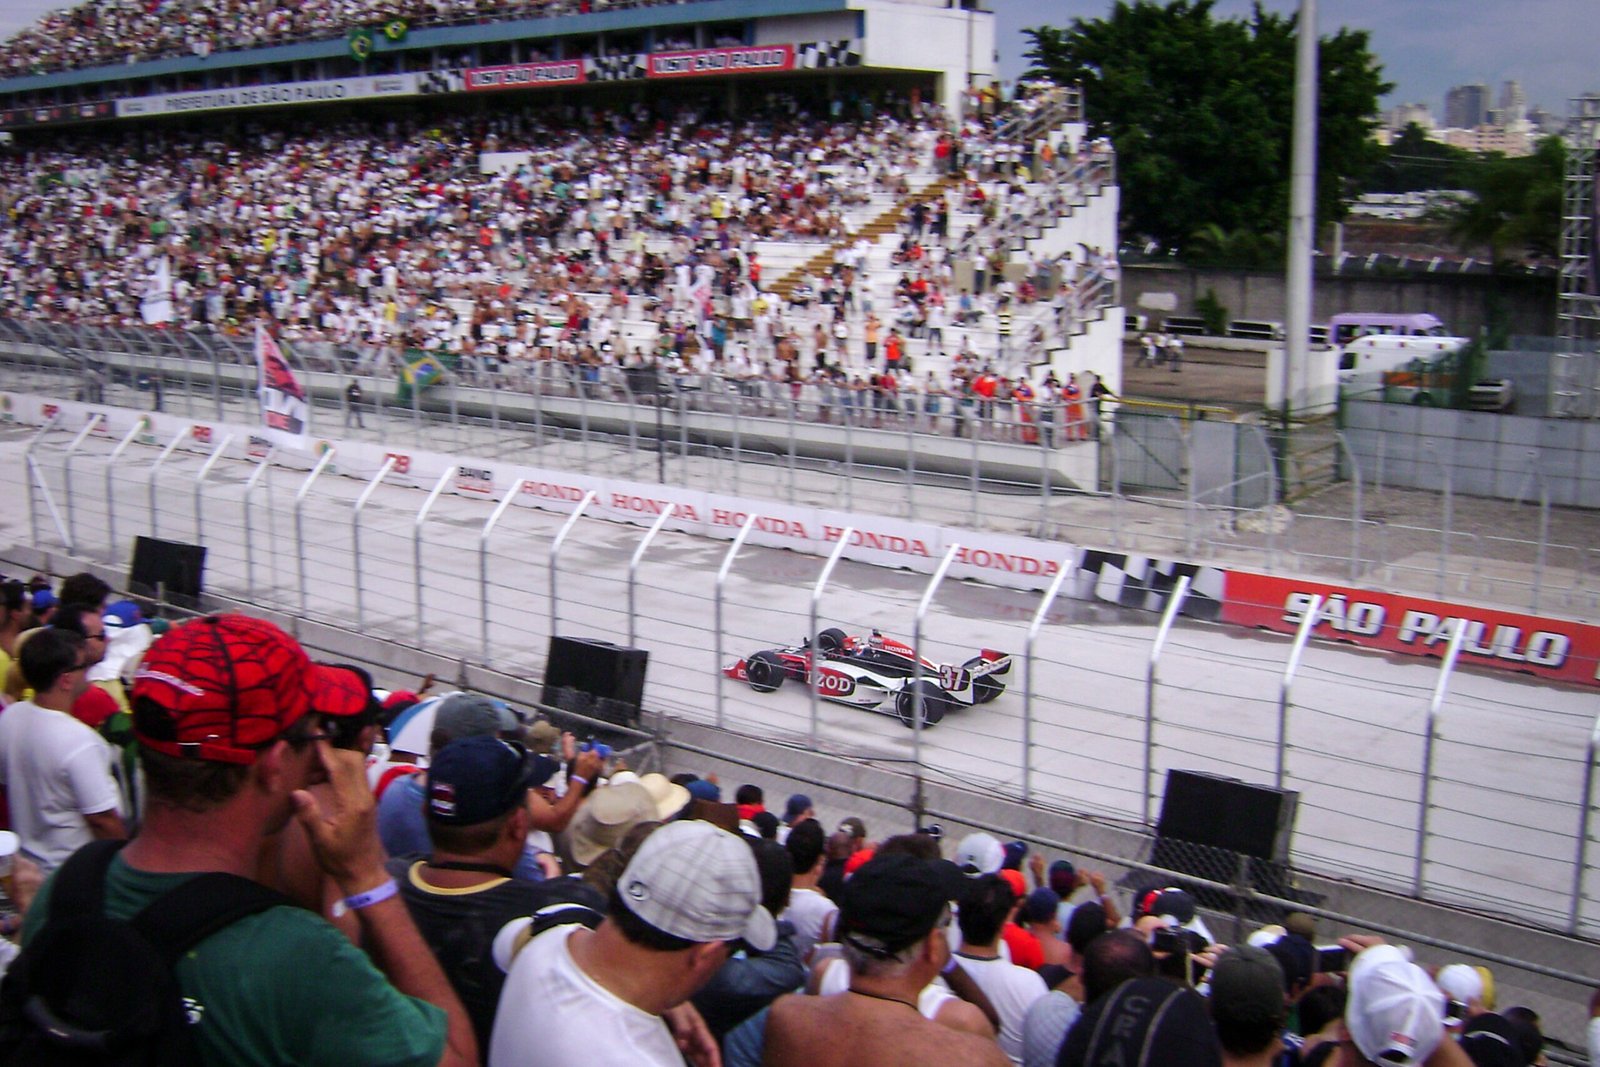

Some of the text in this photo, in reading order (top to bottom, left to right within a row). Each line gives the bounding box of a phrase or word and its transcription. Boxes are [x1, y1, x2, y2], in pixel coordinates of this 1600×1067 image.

[533, 64, 579, 82] PAULO
[654, 49, 786, 73] VISIT SÃO PAULO
[165, 84, 345, 110] PREFEITURA DE SÃO PAULO
[822, 525, 929, 557] HONDA
[1281, 591, 1570, 668] SÃO PAULO
[884, 644, 914, 656] HONDA
[940, 664, 965, 691] 37
